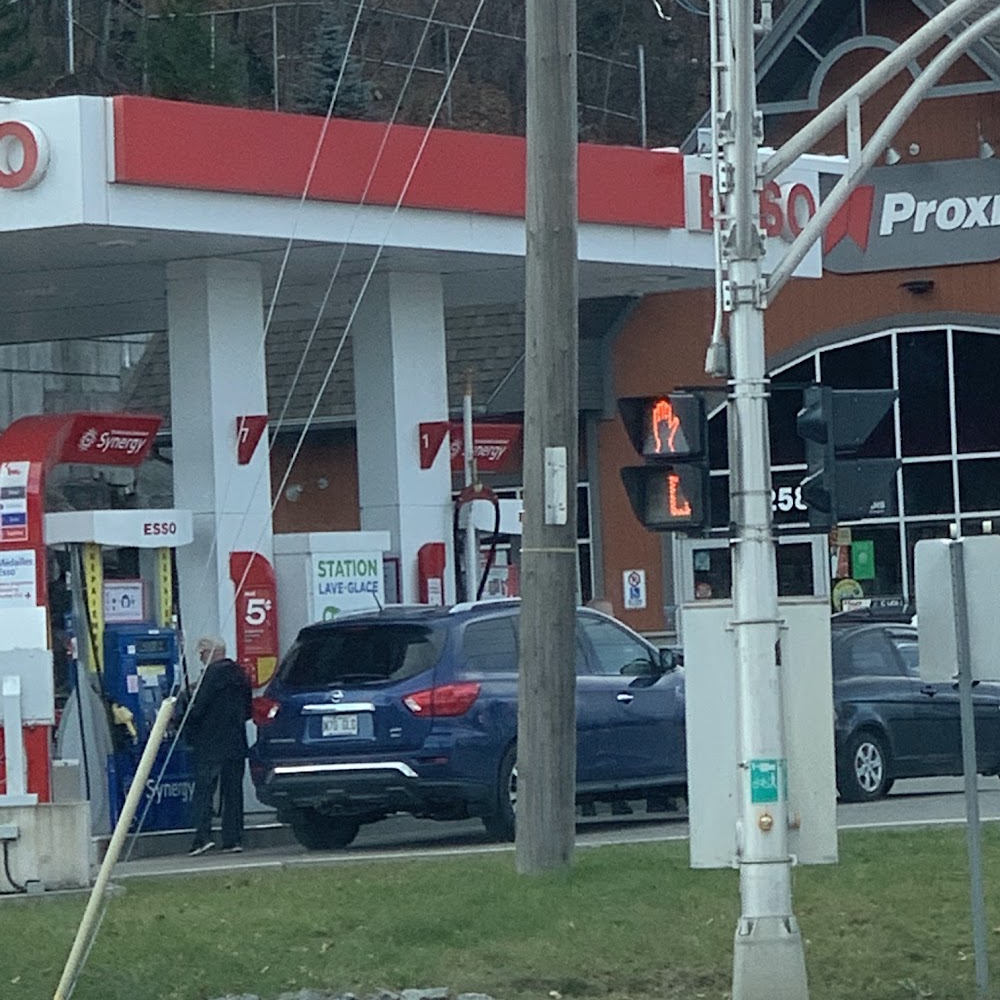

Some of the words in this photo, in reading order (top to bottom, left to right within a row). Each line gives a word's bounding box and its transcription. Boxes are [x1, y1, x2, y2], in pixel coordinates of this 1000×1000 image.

[700, 174, 817, 238] ESO
[96, 431, 147, 454] Synergy
[422, 433, 429, 449] 1
[144, 523, 177, 535] ESSO
[318, 559, 378, 577] STATION
[319, 581, 379, 594] LAVE-GLACE
[145, 779, 196, 803] Synergy
